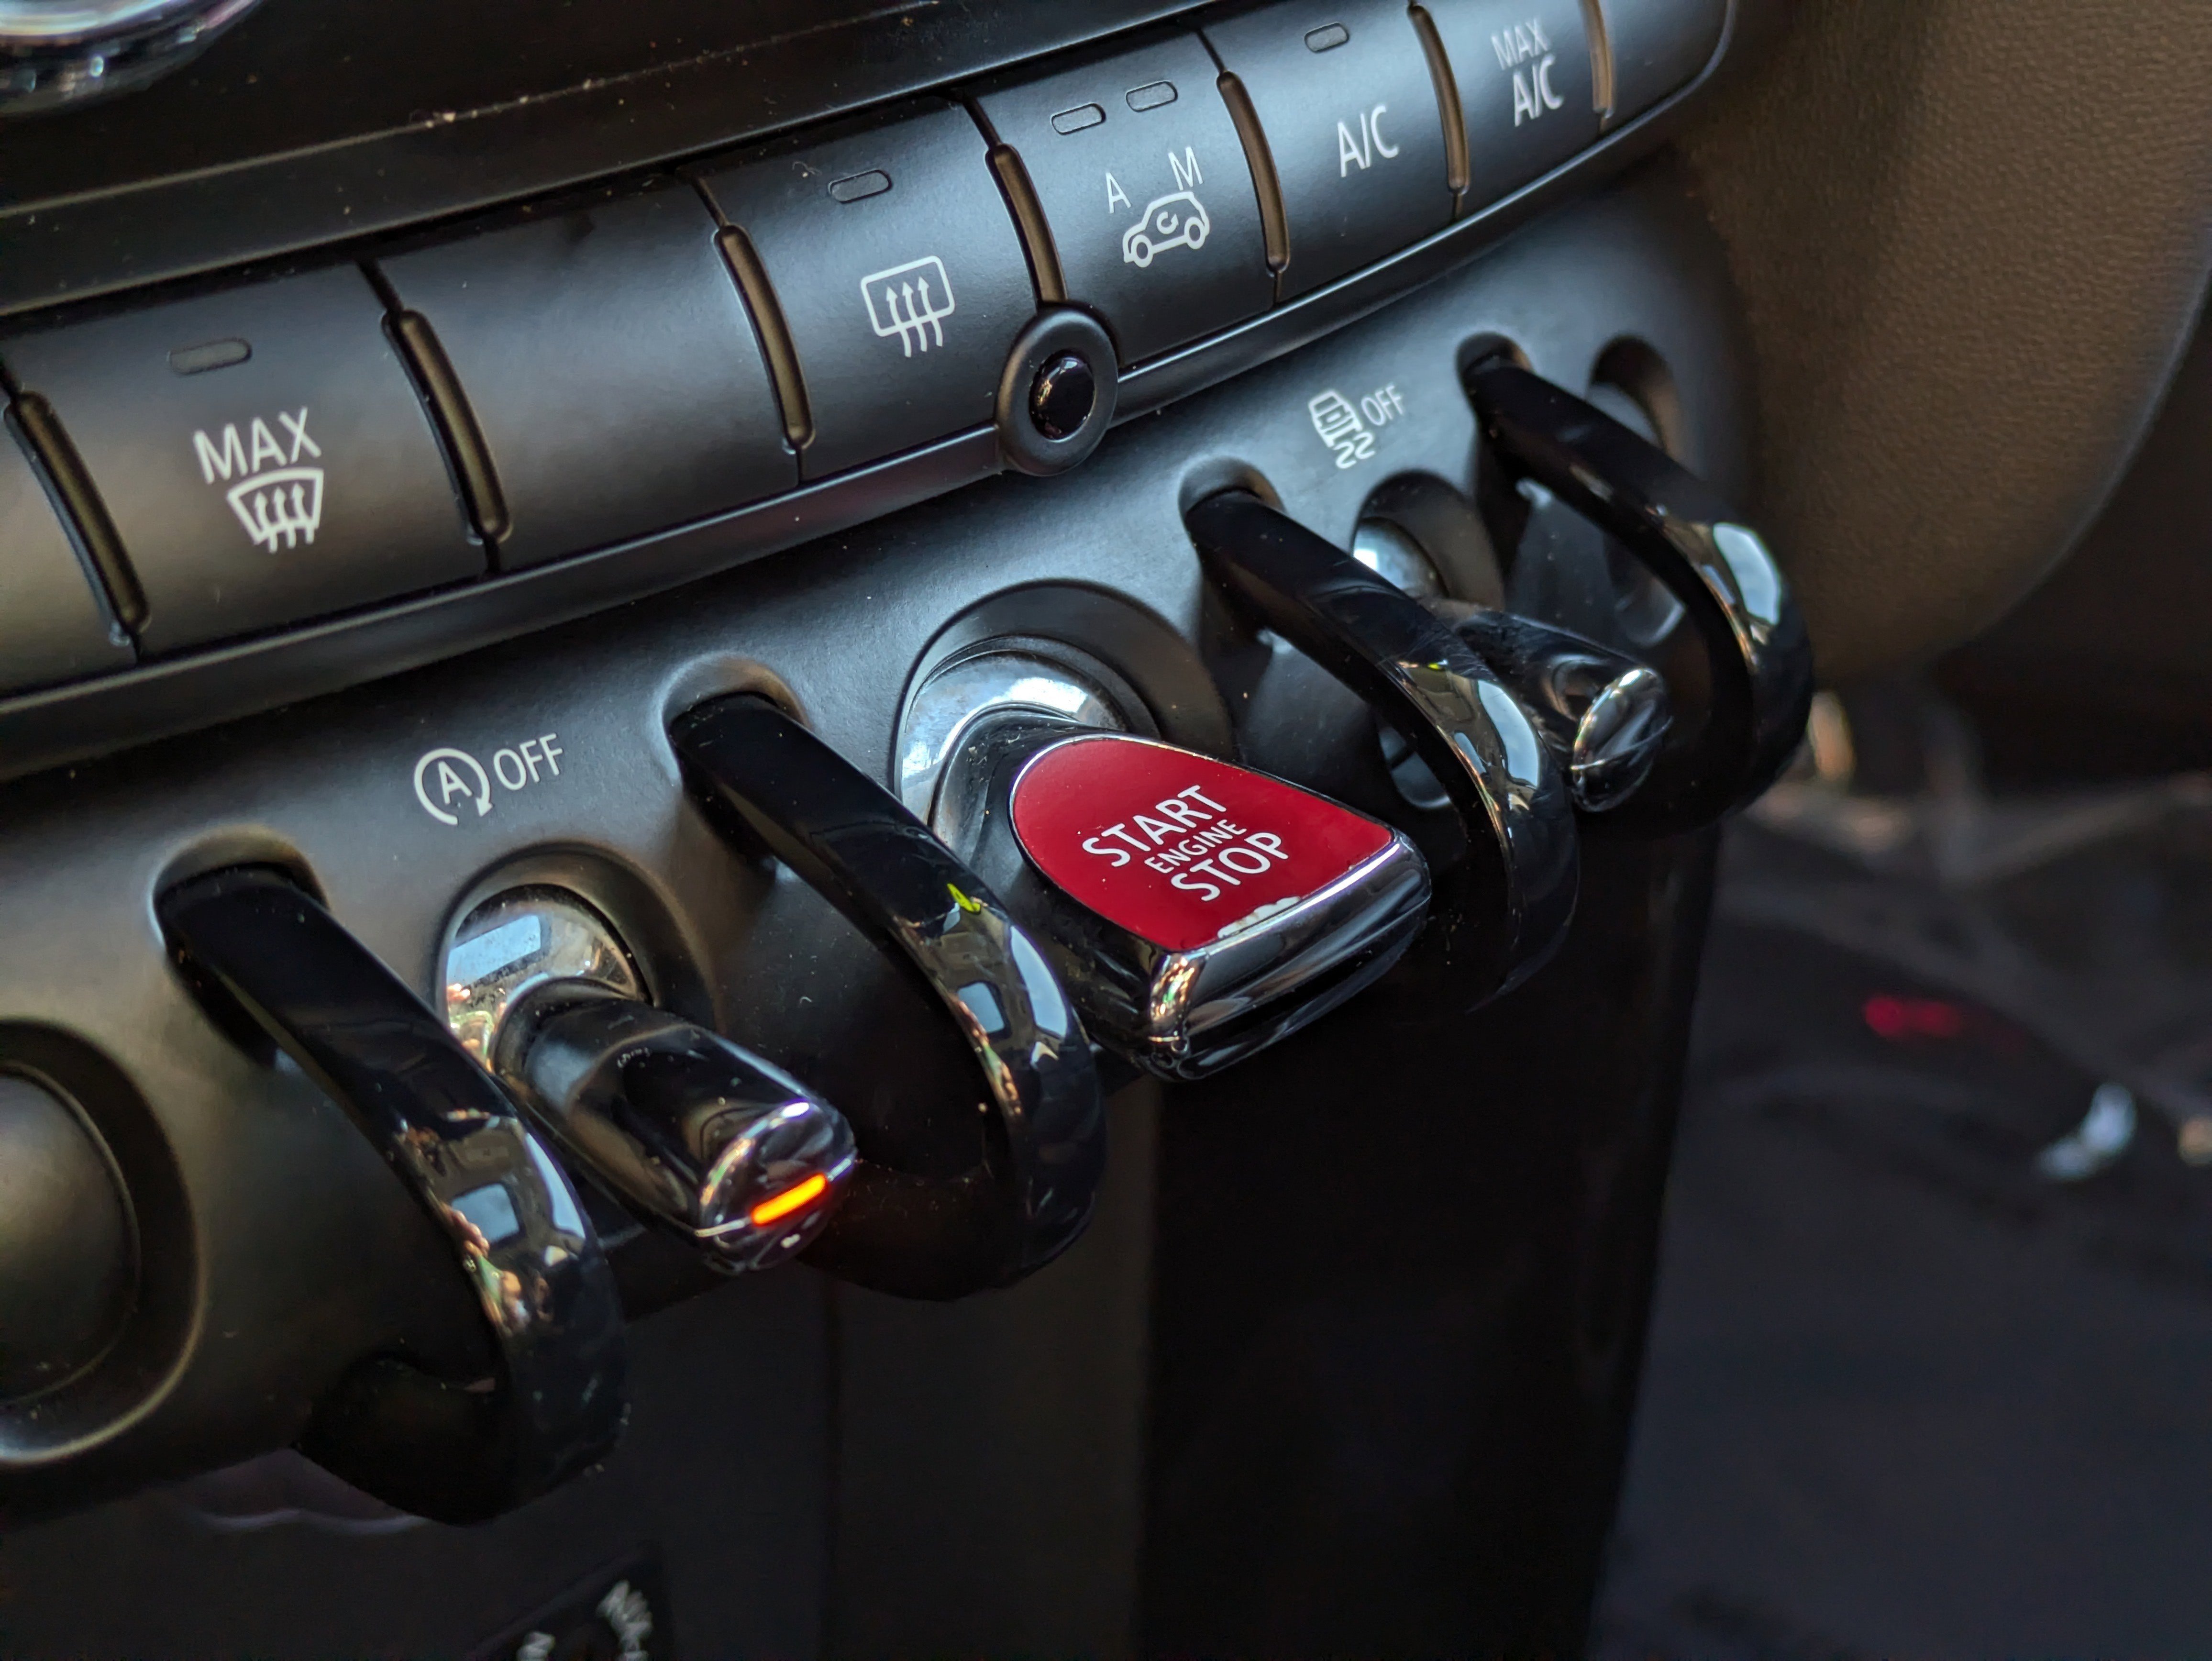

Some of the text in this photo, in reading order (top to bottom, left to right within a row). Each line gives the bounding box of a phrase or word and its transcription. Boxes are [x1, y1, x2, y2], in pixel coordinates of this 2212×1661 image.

[1491, 19, 1550, 71] MAX
[1513, 54, 1563, 127] A/C
[1338, 104, 1399, 177] A/C
[1106, 146, 1203, 213] A M
[1361, 385, 1404, 426] OFF
[193, 406, 321, 485] MAX
[493, 733, 563, 790] OFF
[1082, 785, 1227, 867] START
[1144, 819, 1247, 873] ENGINE
[1171, 832, 1288, 901] STOP
